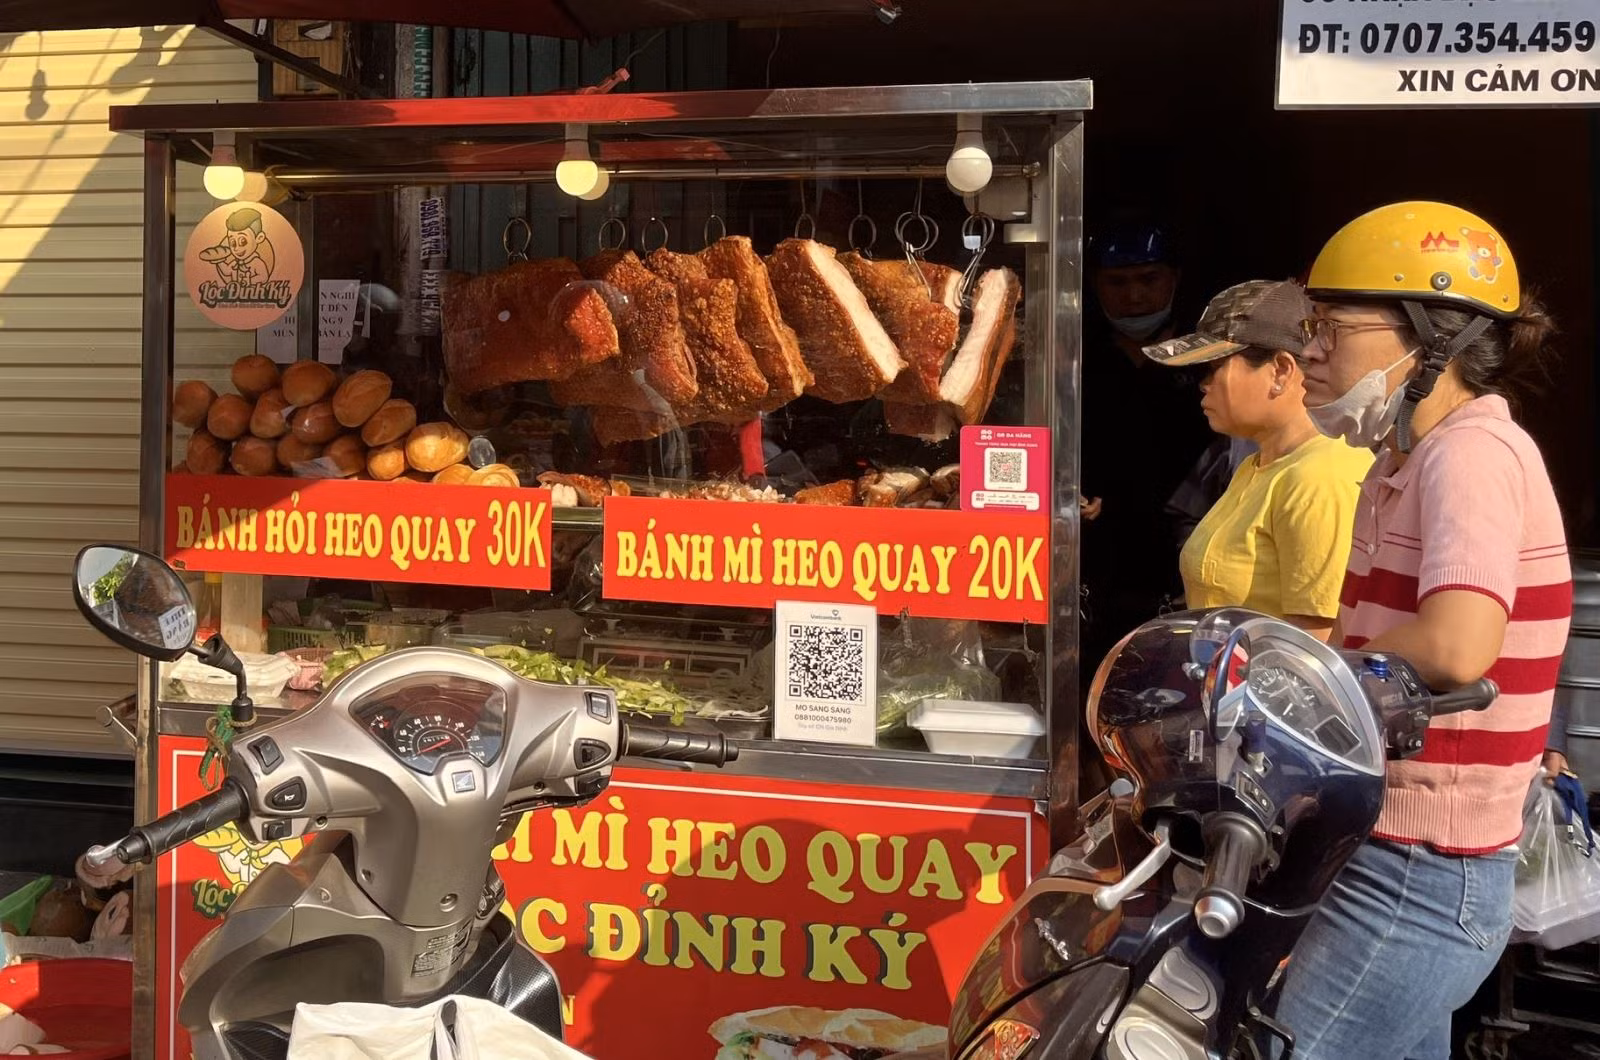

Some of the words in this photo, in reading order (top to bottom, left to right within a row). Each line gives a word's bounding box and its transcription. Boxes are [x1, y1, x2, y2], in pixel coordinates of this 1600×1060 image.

[1298, 23, 1350, 54] ĐT:
[1360, 20, 1596, 54] 0707.354.459
[1396, 69, 1455, 92] XIN
[1464, 63, 1540, 92] CẢM
[1550, 68, 1600, 92] ƠN
[177, 493, 258, 551] BÁNH
[265, 491, 317, 555] HỎI
[324, 512, 383, 558] HEO
[390, 515, 477, 571] QUAY
[487, 499, 547, 568] 30K
[616, 518, 714, 582] BÁNH
[723, 522, 763, 585] MÌ
[772, 537, 843, 588] HEO
[852, 542, 957, 602] QUAY
[967, 535, 1044, 601] 20K
[809, 705, 829, 713] SANG
[830, 706, 851, 714] SANG
[551, 796, 628, 870] MÌ
[647, 817, 787, 884] HEO
[807, 830, 1018, 904] QUAY
[586, 883, 786, 977] ĐỈNH
[806, 912, 927, 990] KÝ
